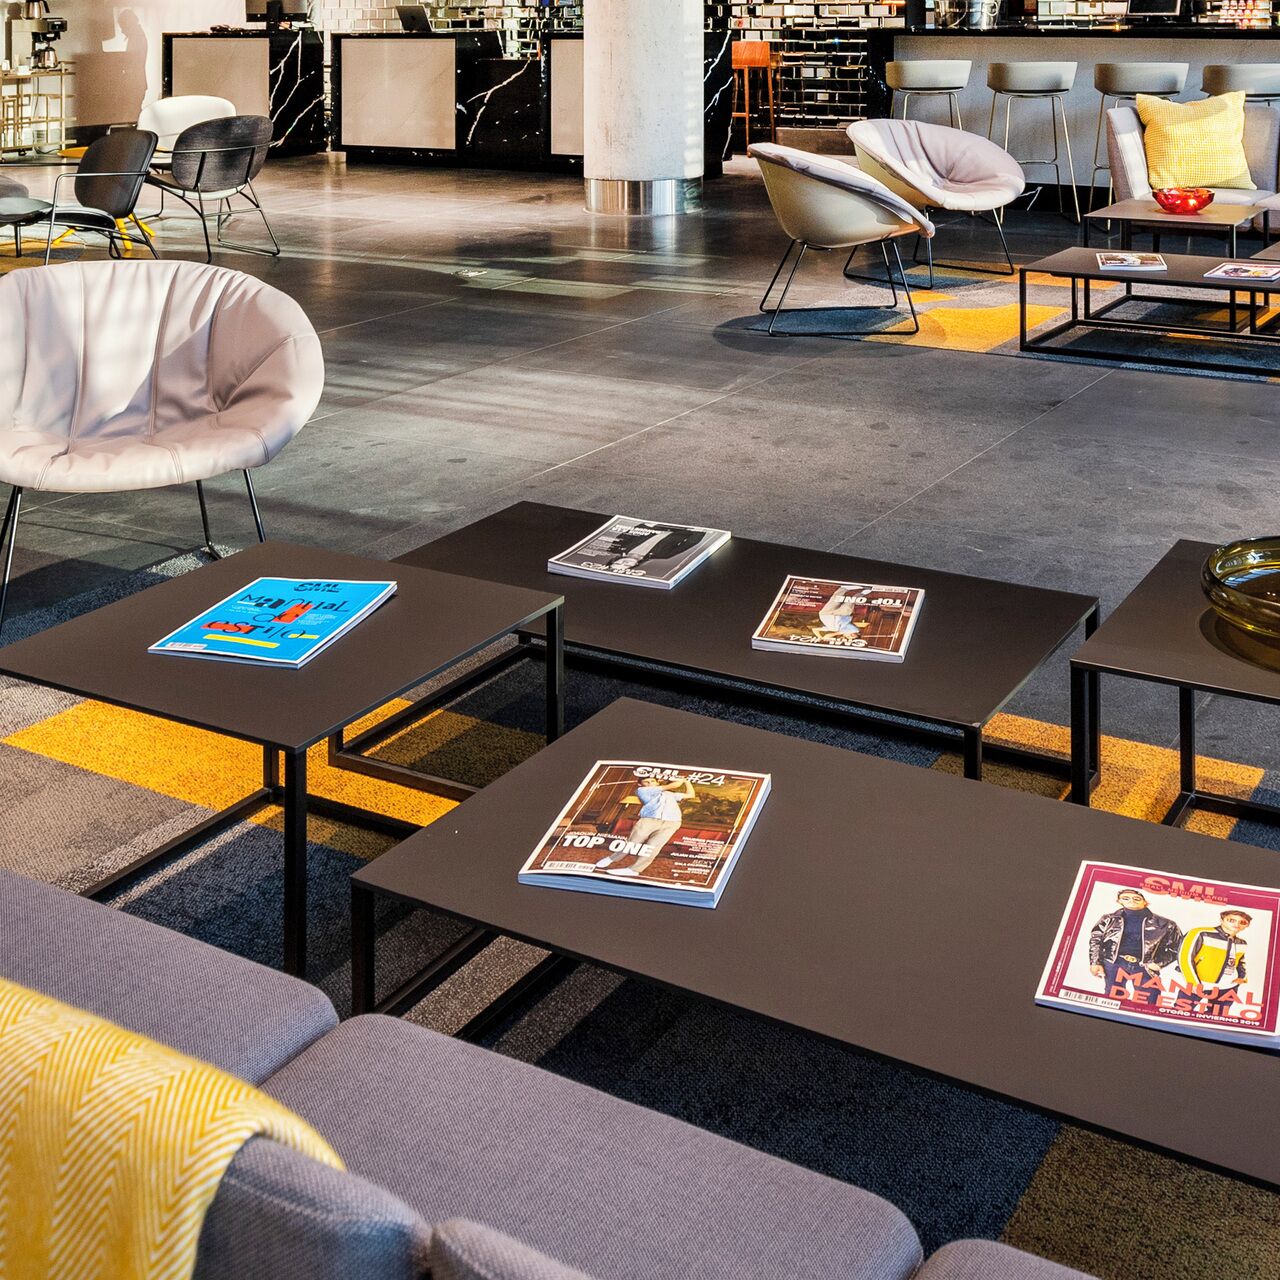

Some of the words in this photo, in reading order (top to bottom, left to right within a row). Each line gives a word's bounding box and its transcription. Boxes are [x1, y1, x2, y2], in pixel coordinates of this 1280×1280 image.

[632, 766, 685, 781] SML
[686, 772, 726, 787] #24
[562, 834, 606, 849] TOP
[608, 839, 656, 858] ONE
[1141, 876, 1227, 906] SML
[1115, 967, 1264, 1007] MANUAL
[1109, 985, 1150, 1005] DE
[1155, 993, 1263, 1021] ESTILO
[1195, 1012, 1239, 1024] INVIERNO
[1239, 1019, 1261, 1027] 2019
